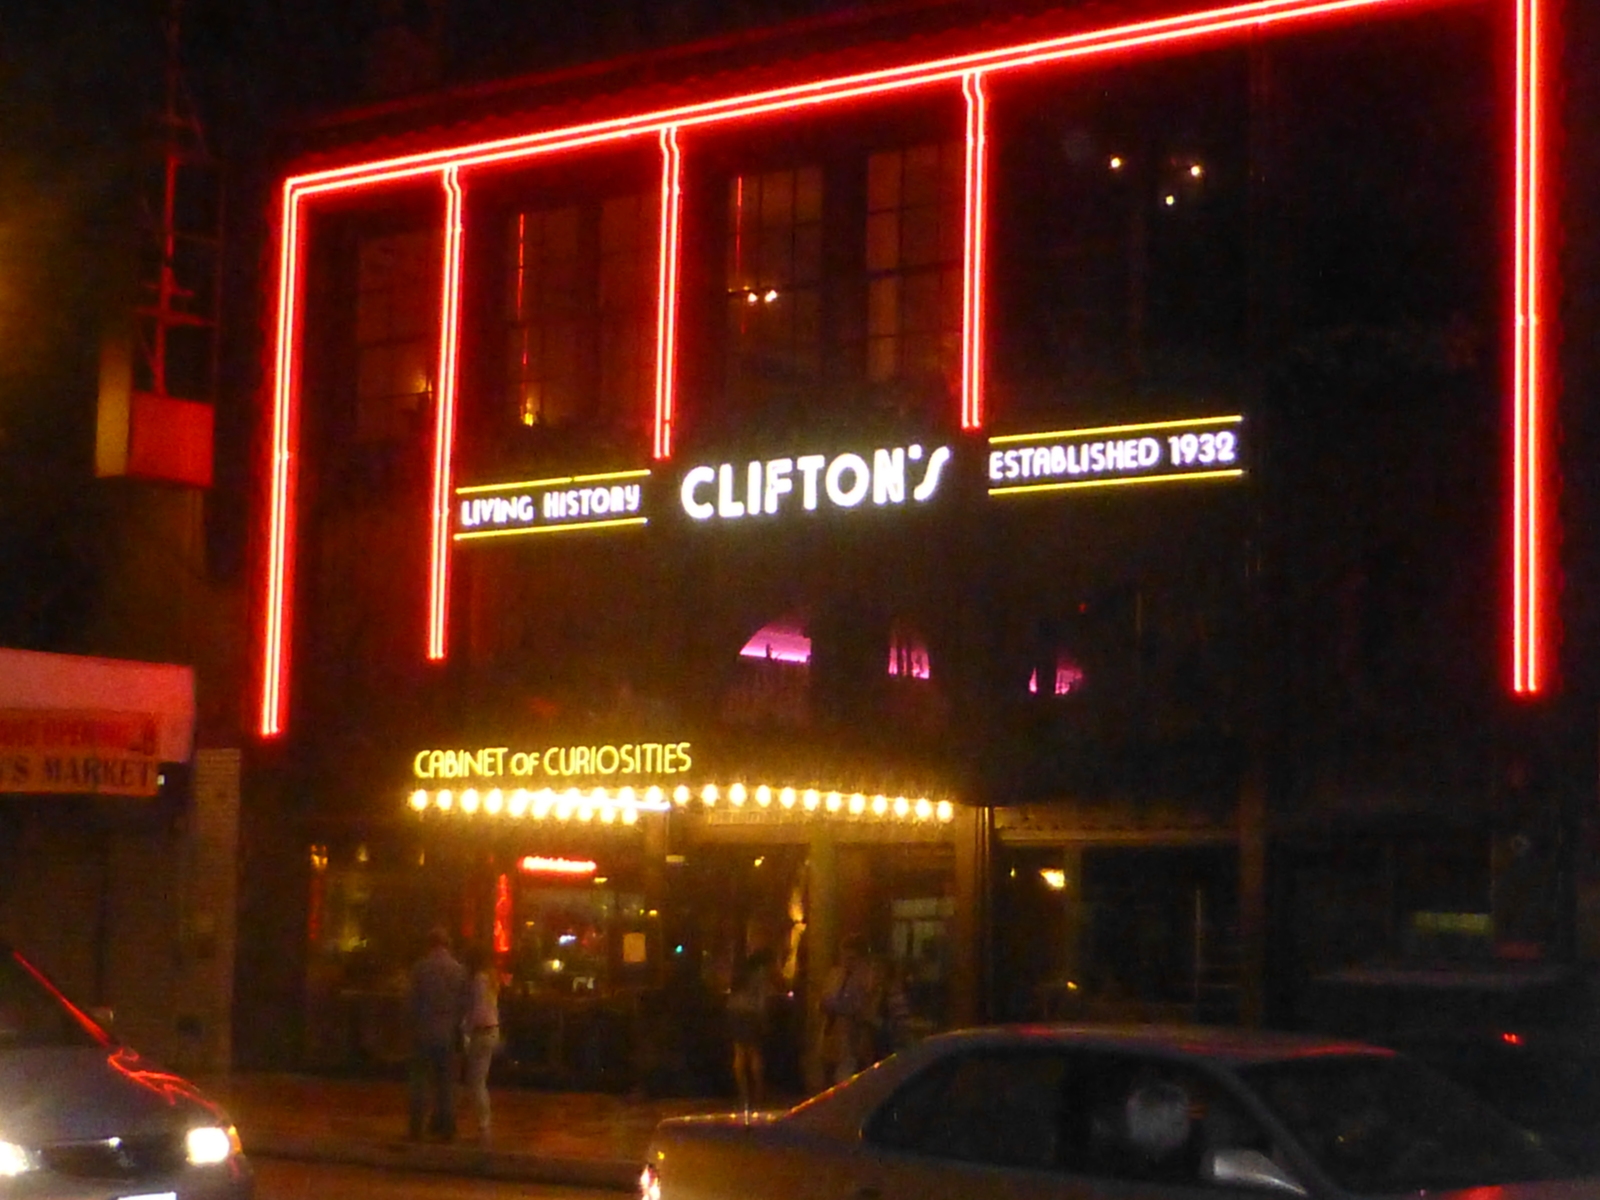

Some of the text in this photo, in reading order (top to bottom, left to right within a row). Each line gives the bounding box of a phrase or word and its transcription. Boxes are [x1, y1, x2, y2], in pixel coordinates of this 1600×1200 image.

[988, 431, 1236, 480] ESTABLISHED 1932
[680, 443, 951, 520] CLIFTON'S
[461, 484, 641, 526] LIVING HISTORY
[44, 756, 152, 787] MARKET
[413, 747, 509, 778] CABINET
[543, 742, 693, 776] CURIOSITIES
